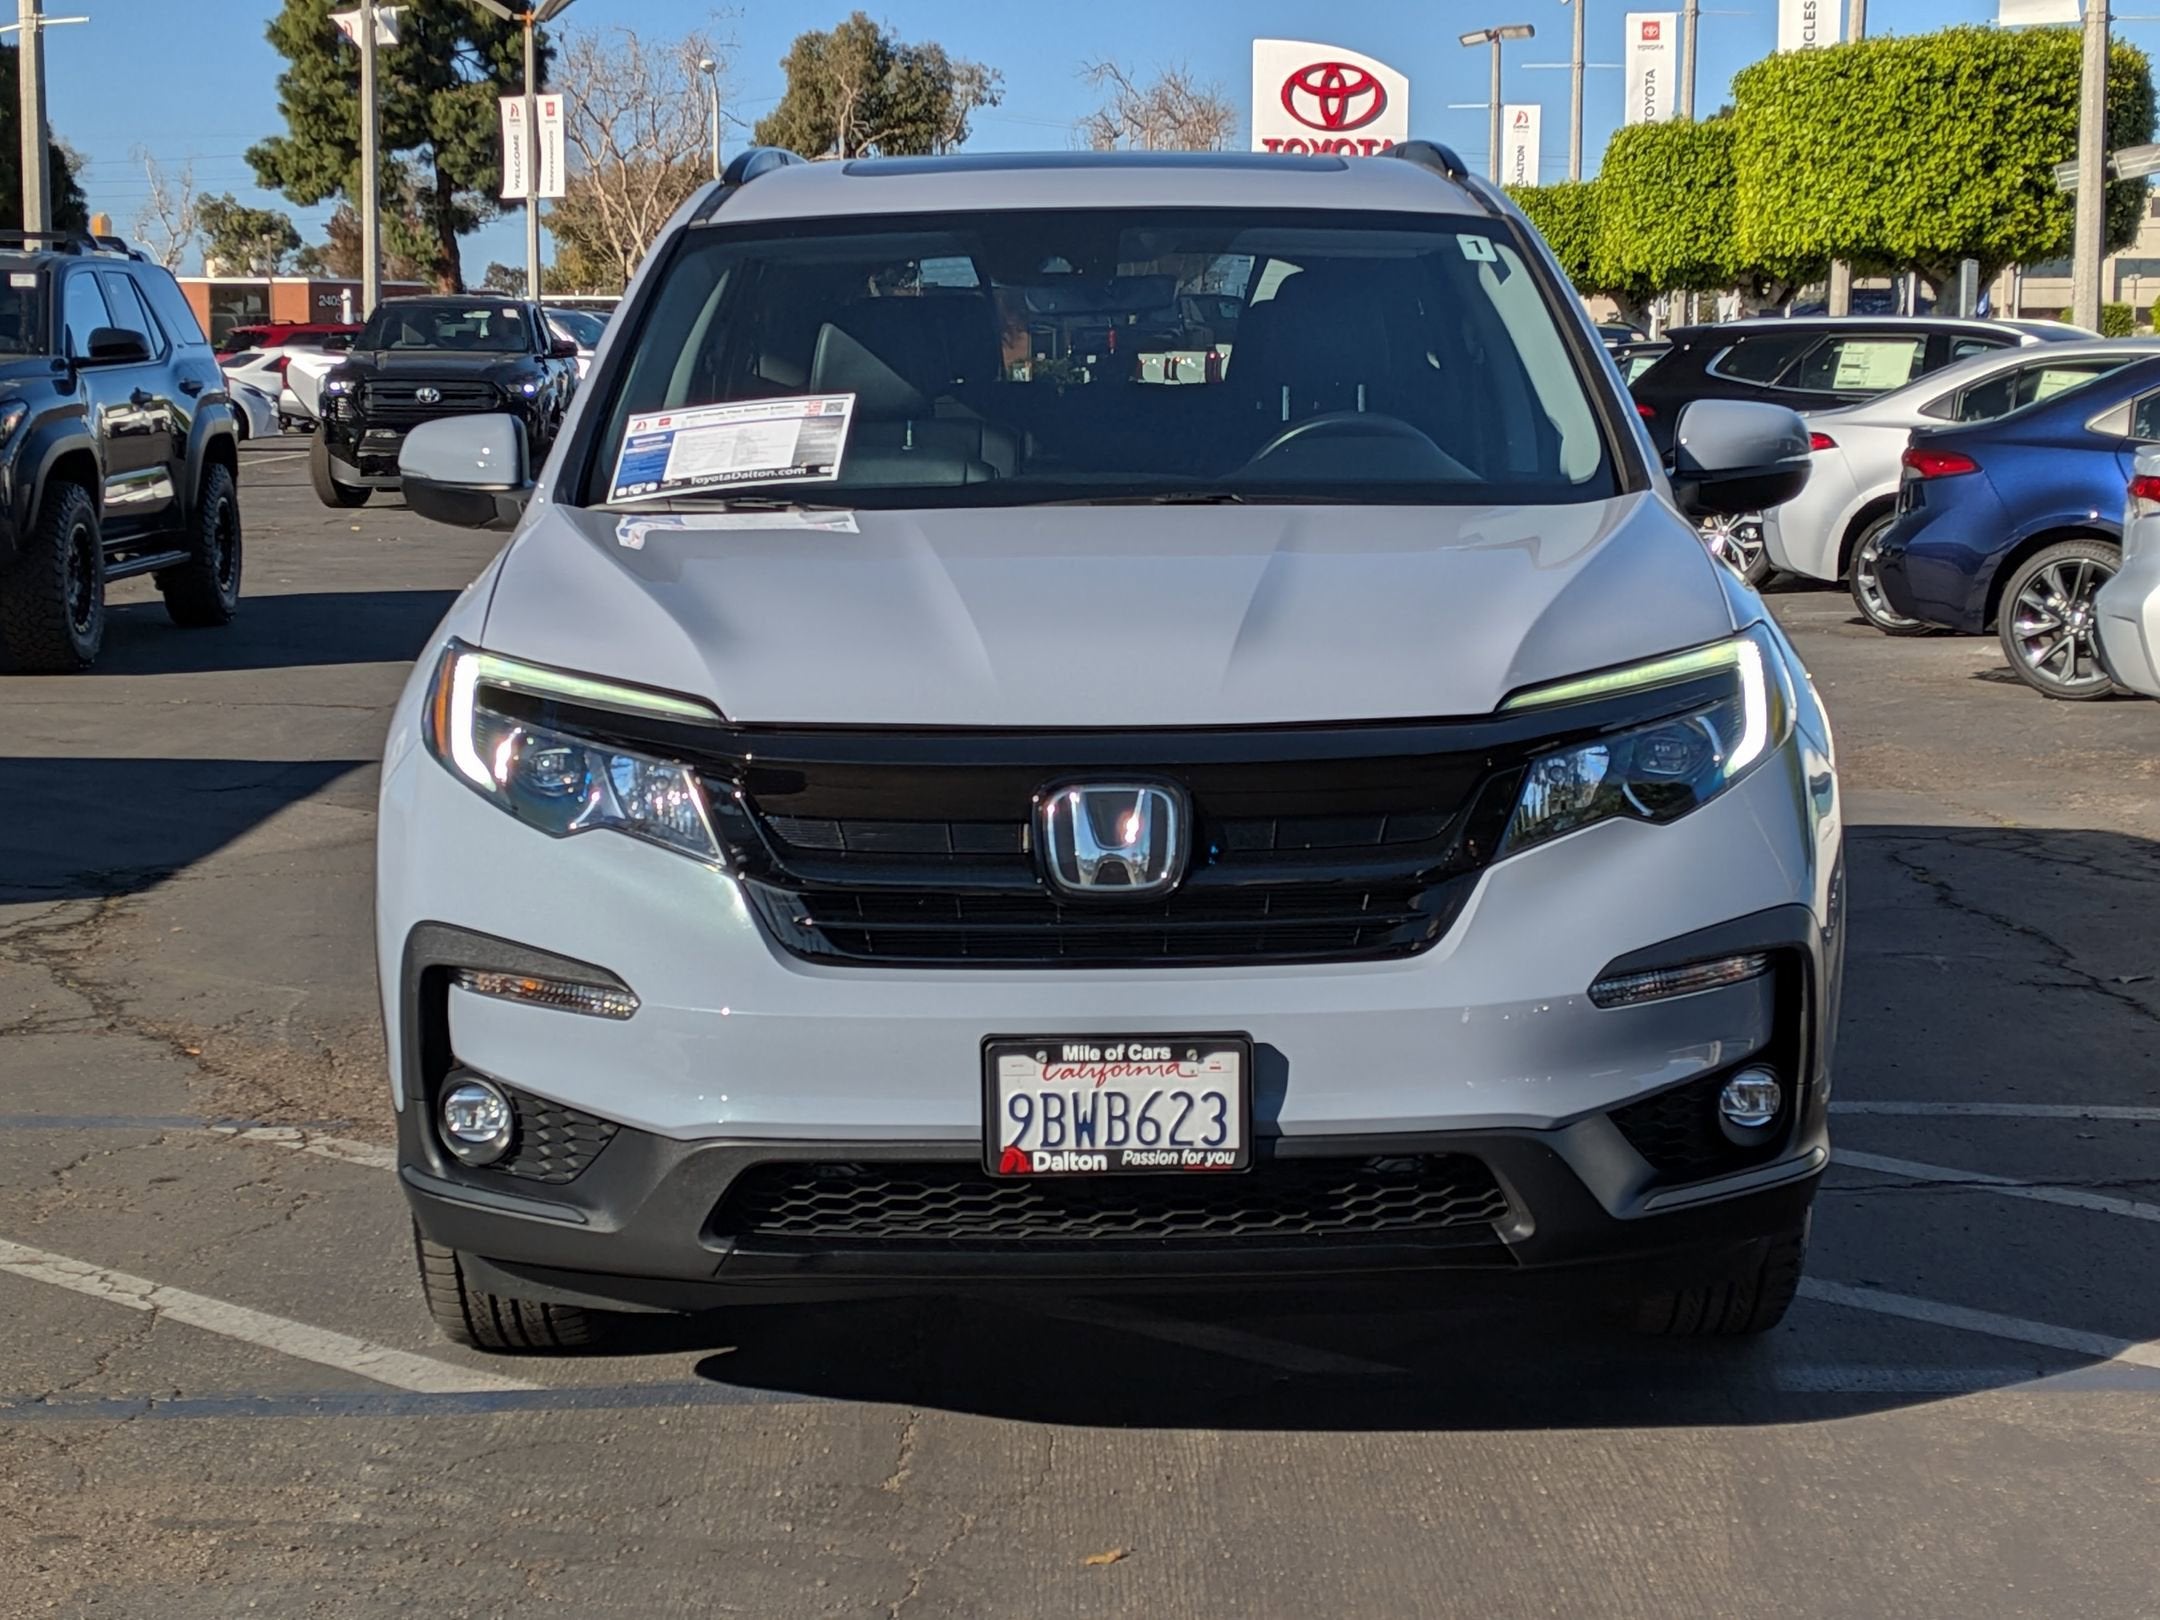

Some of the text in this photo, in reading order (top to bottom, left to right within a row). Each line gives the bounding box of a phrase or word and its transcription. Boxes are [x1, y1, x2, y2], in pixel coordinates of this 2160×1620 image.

[513, 134, 521, 190] WELCOME
[690, 465, 807, 486] ToyotaDalton.com
[1062, 1044, 1171, 1062] Mile of Cars
[1042, 1060, 1198, 1087] California
[1007, 1090, 1228, 1148] 9BWB623
[1032, 1151, 1107, 1172] Dalton
[1121, 1149, 1236, 1167] Passion for you
